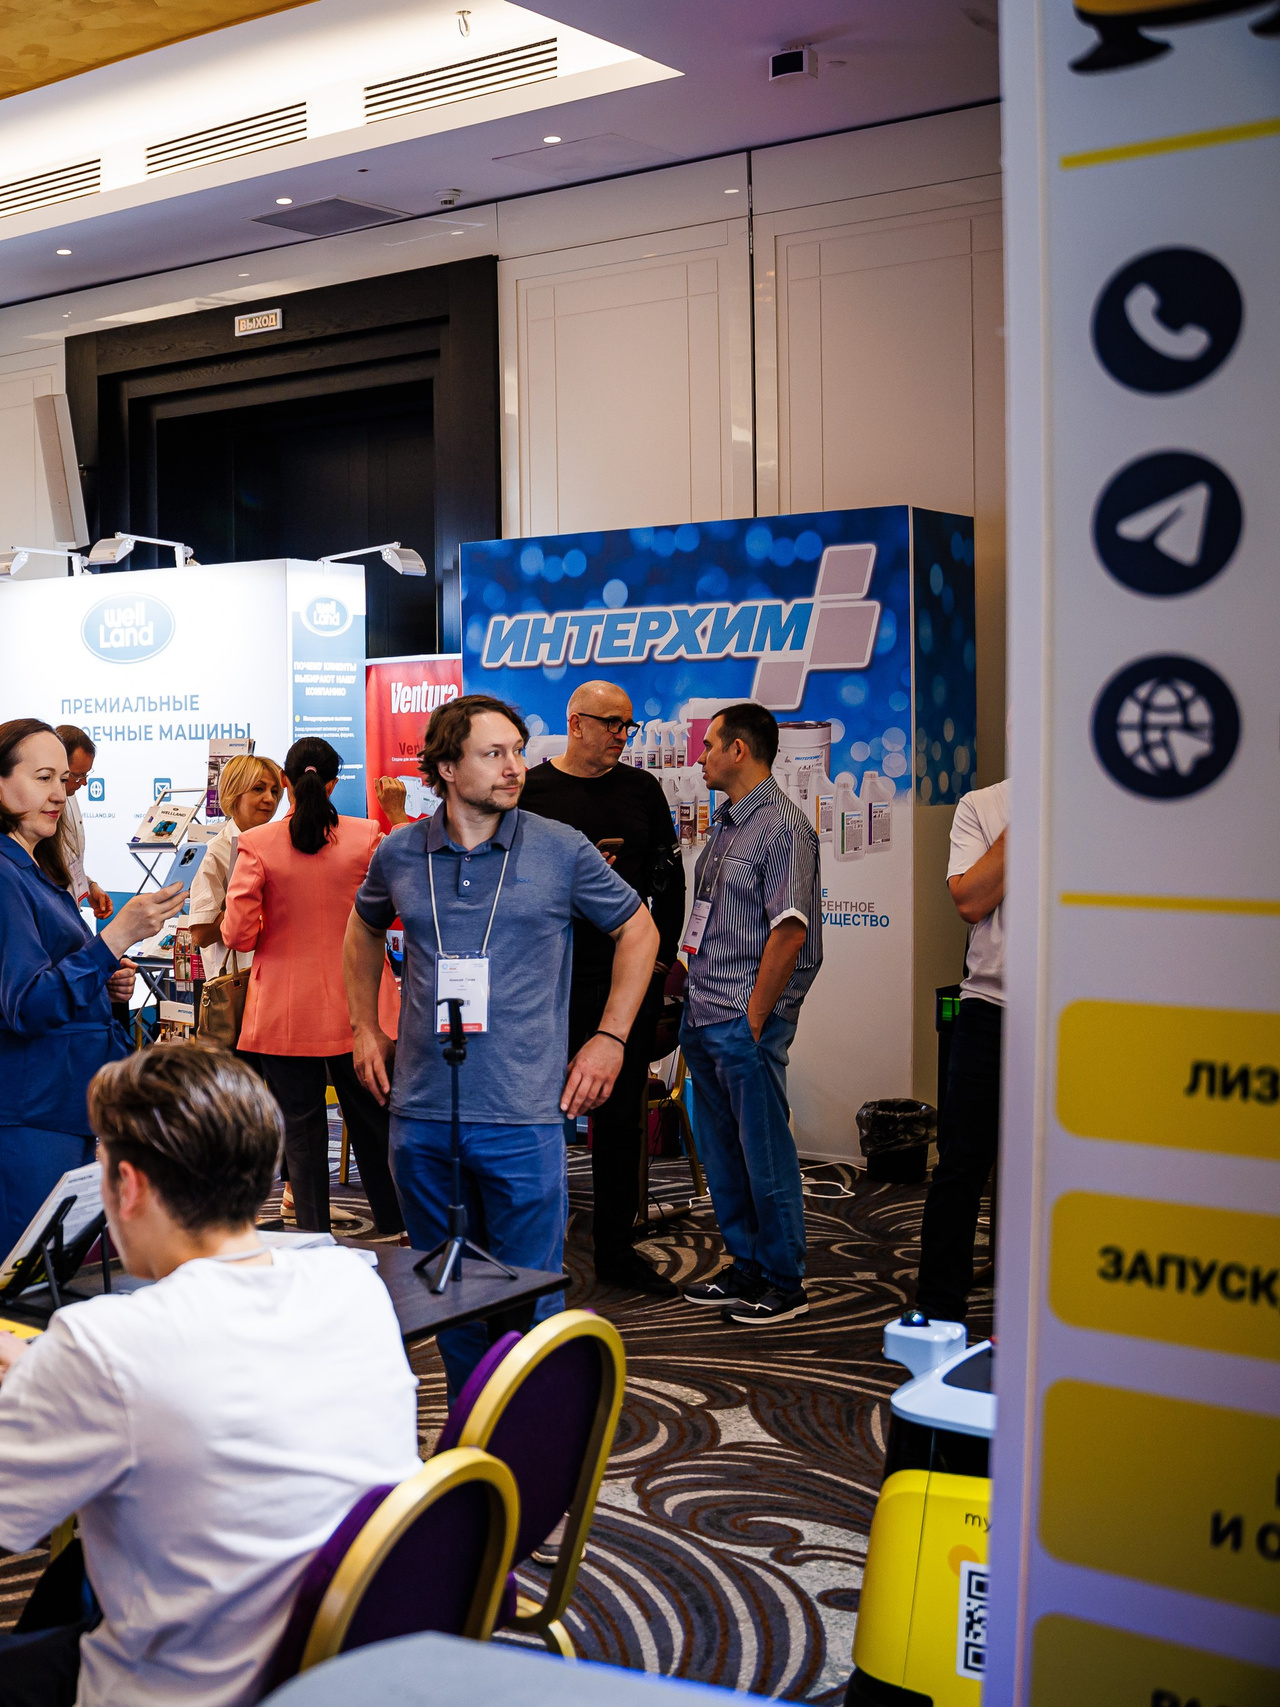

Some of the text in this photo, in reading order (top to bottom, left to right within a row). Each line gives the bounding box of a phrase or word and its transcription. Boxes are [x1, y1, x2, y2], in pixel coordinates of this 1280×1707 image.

[239, 313, 277, 332] ВЫХОД
[104, 600, 146, 628] well
[99, 620, 154, 649] Land
[485, 602, 815, 664] ИНТЕРХИМ
[61, 694, 200, 715] ПРЕМИАЛЬНЫЕ
[390, 680, 459, 715] Ventura
[82, 722, 251, 742] ОЕЧНЫЕ МАШИНЫ
[821, 900, 875, 912] РЕНТНОЕ
[821, 912, 890, 927] УЩЕСТВО
[1096, 1244, 1280, 1312] ЗАПУСК
